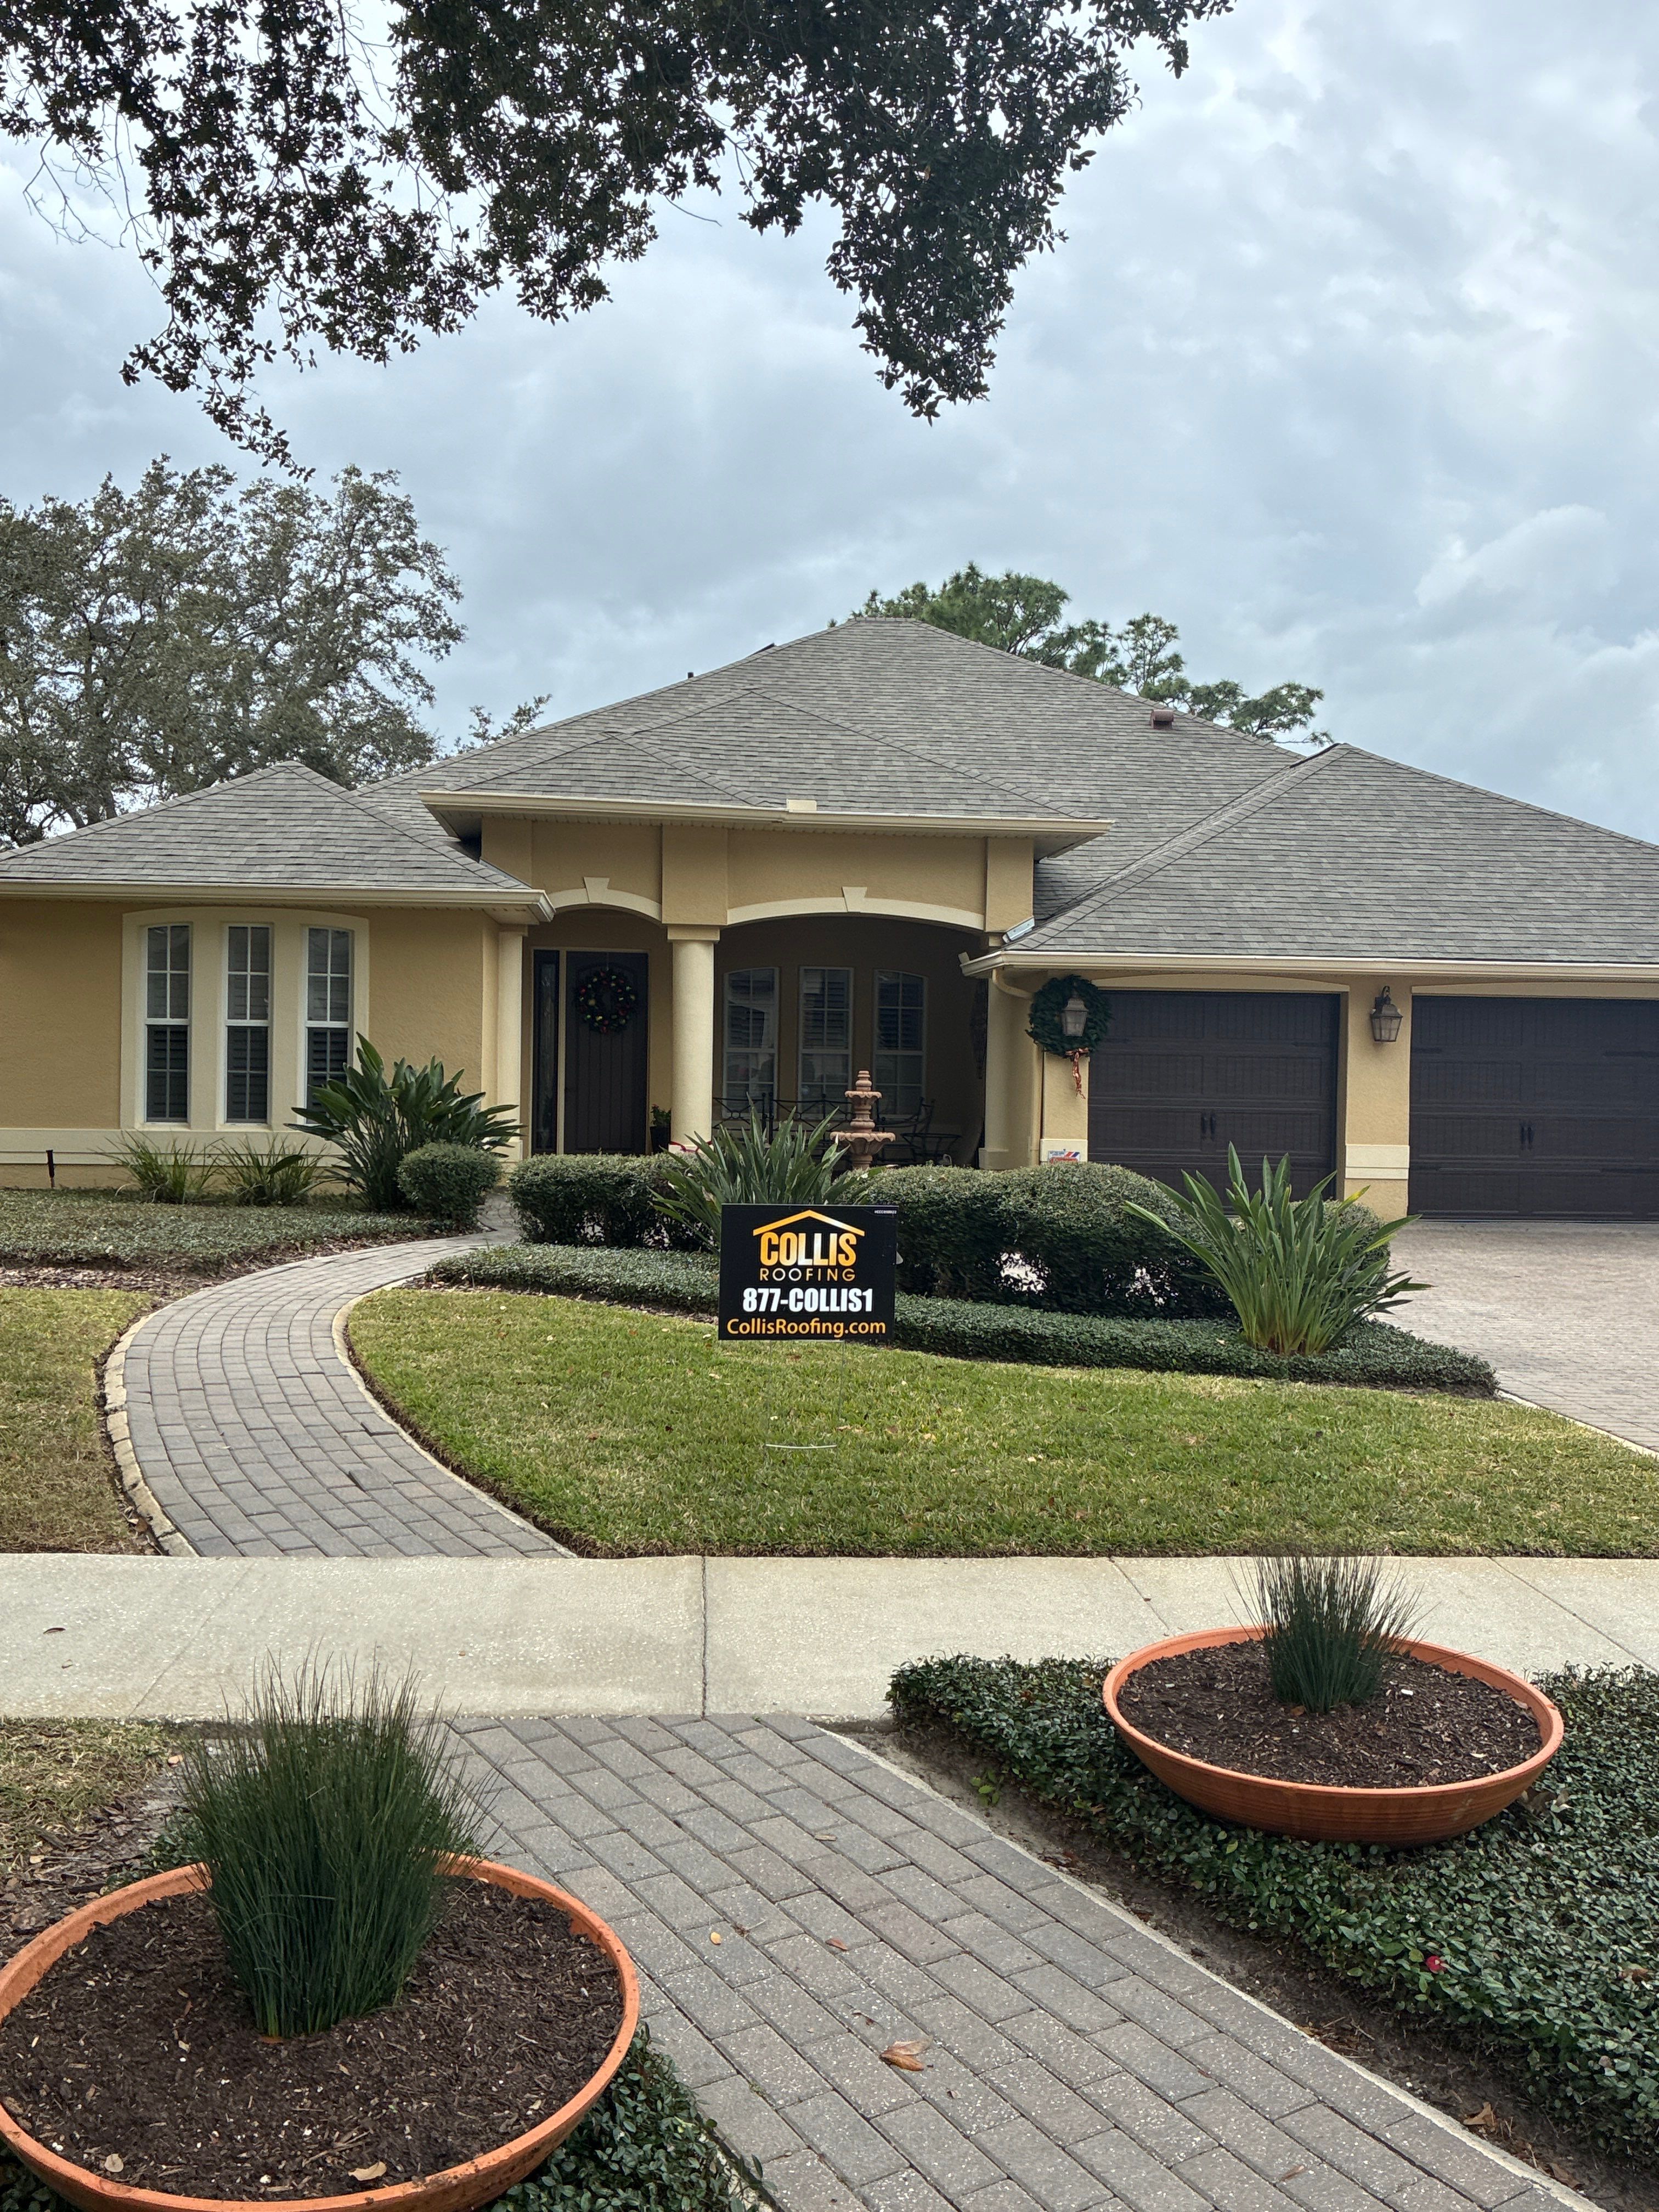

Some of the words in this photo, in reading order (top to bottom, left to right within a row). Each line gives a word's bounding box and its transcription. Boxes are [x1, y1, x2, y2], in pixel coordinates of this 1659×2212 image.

[760, 1232, 857, 1266] COLLIS
[760, 1268, 855, 1282] ROOFING
[743, 1288, 873, 1312] 877-COLLIS1
[727, 1318, 886, 1338] CollisRoofing.com
